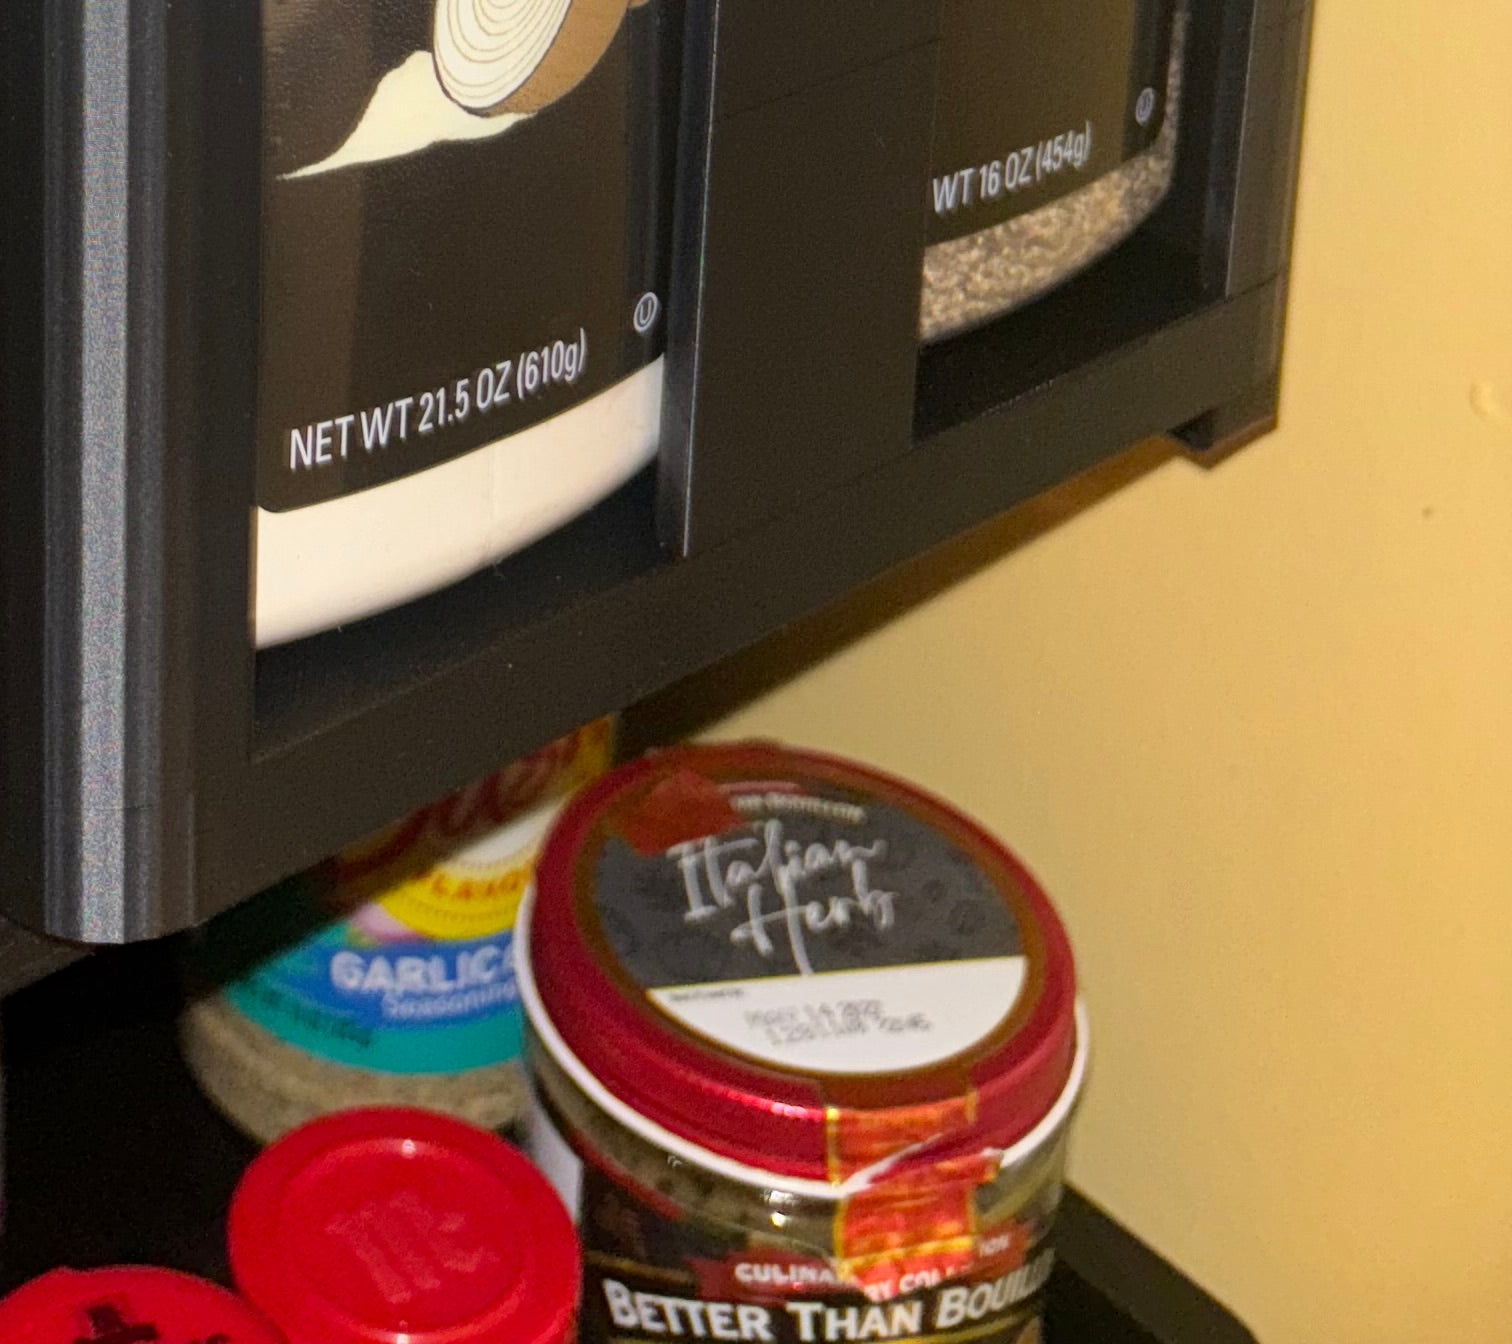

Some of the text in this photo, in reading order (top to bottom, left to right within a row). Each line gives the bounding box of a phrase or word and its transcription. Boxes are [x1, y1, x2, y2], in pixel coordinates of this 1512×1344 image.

[933, 120, 1092, 214] WT 16 OZ (454g)
[290, 328, 587, 469] NET WT 21.5 OZ (610g)
[666, 818, 886, 922] Italian
[330, 944, 500, 992] GARLIC
[603, 1279, 774, 1341] BETTER
[786, 1299, 925, 1342] THAN
